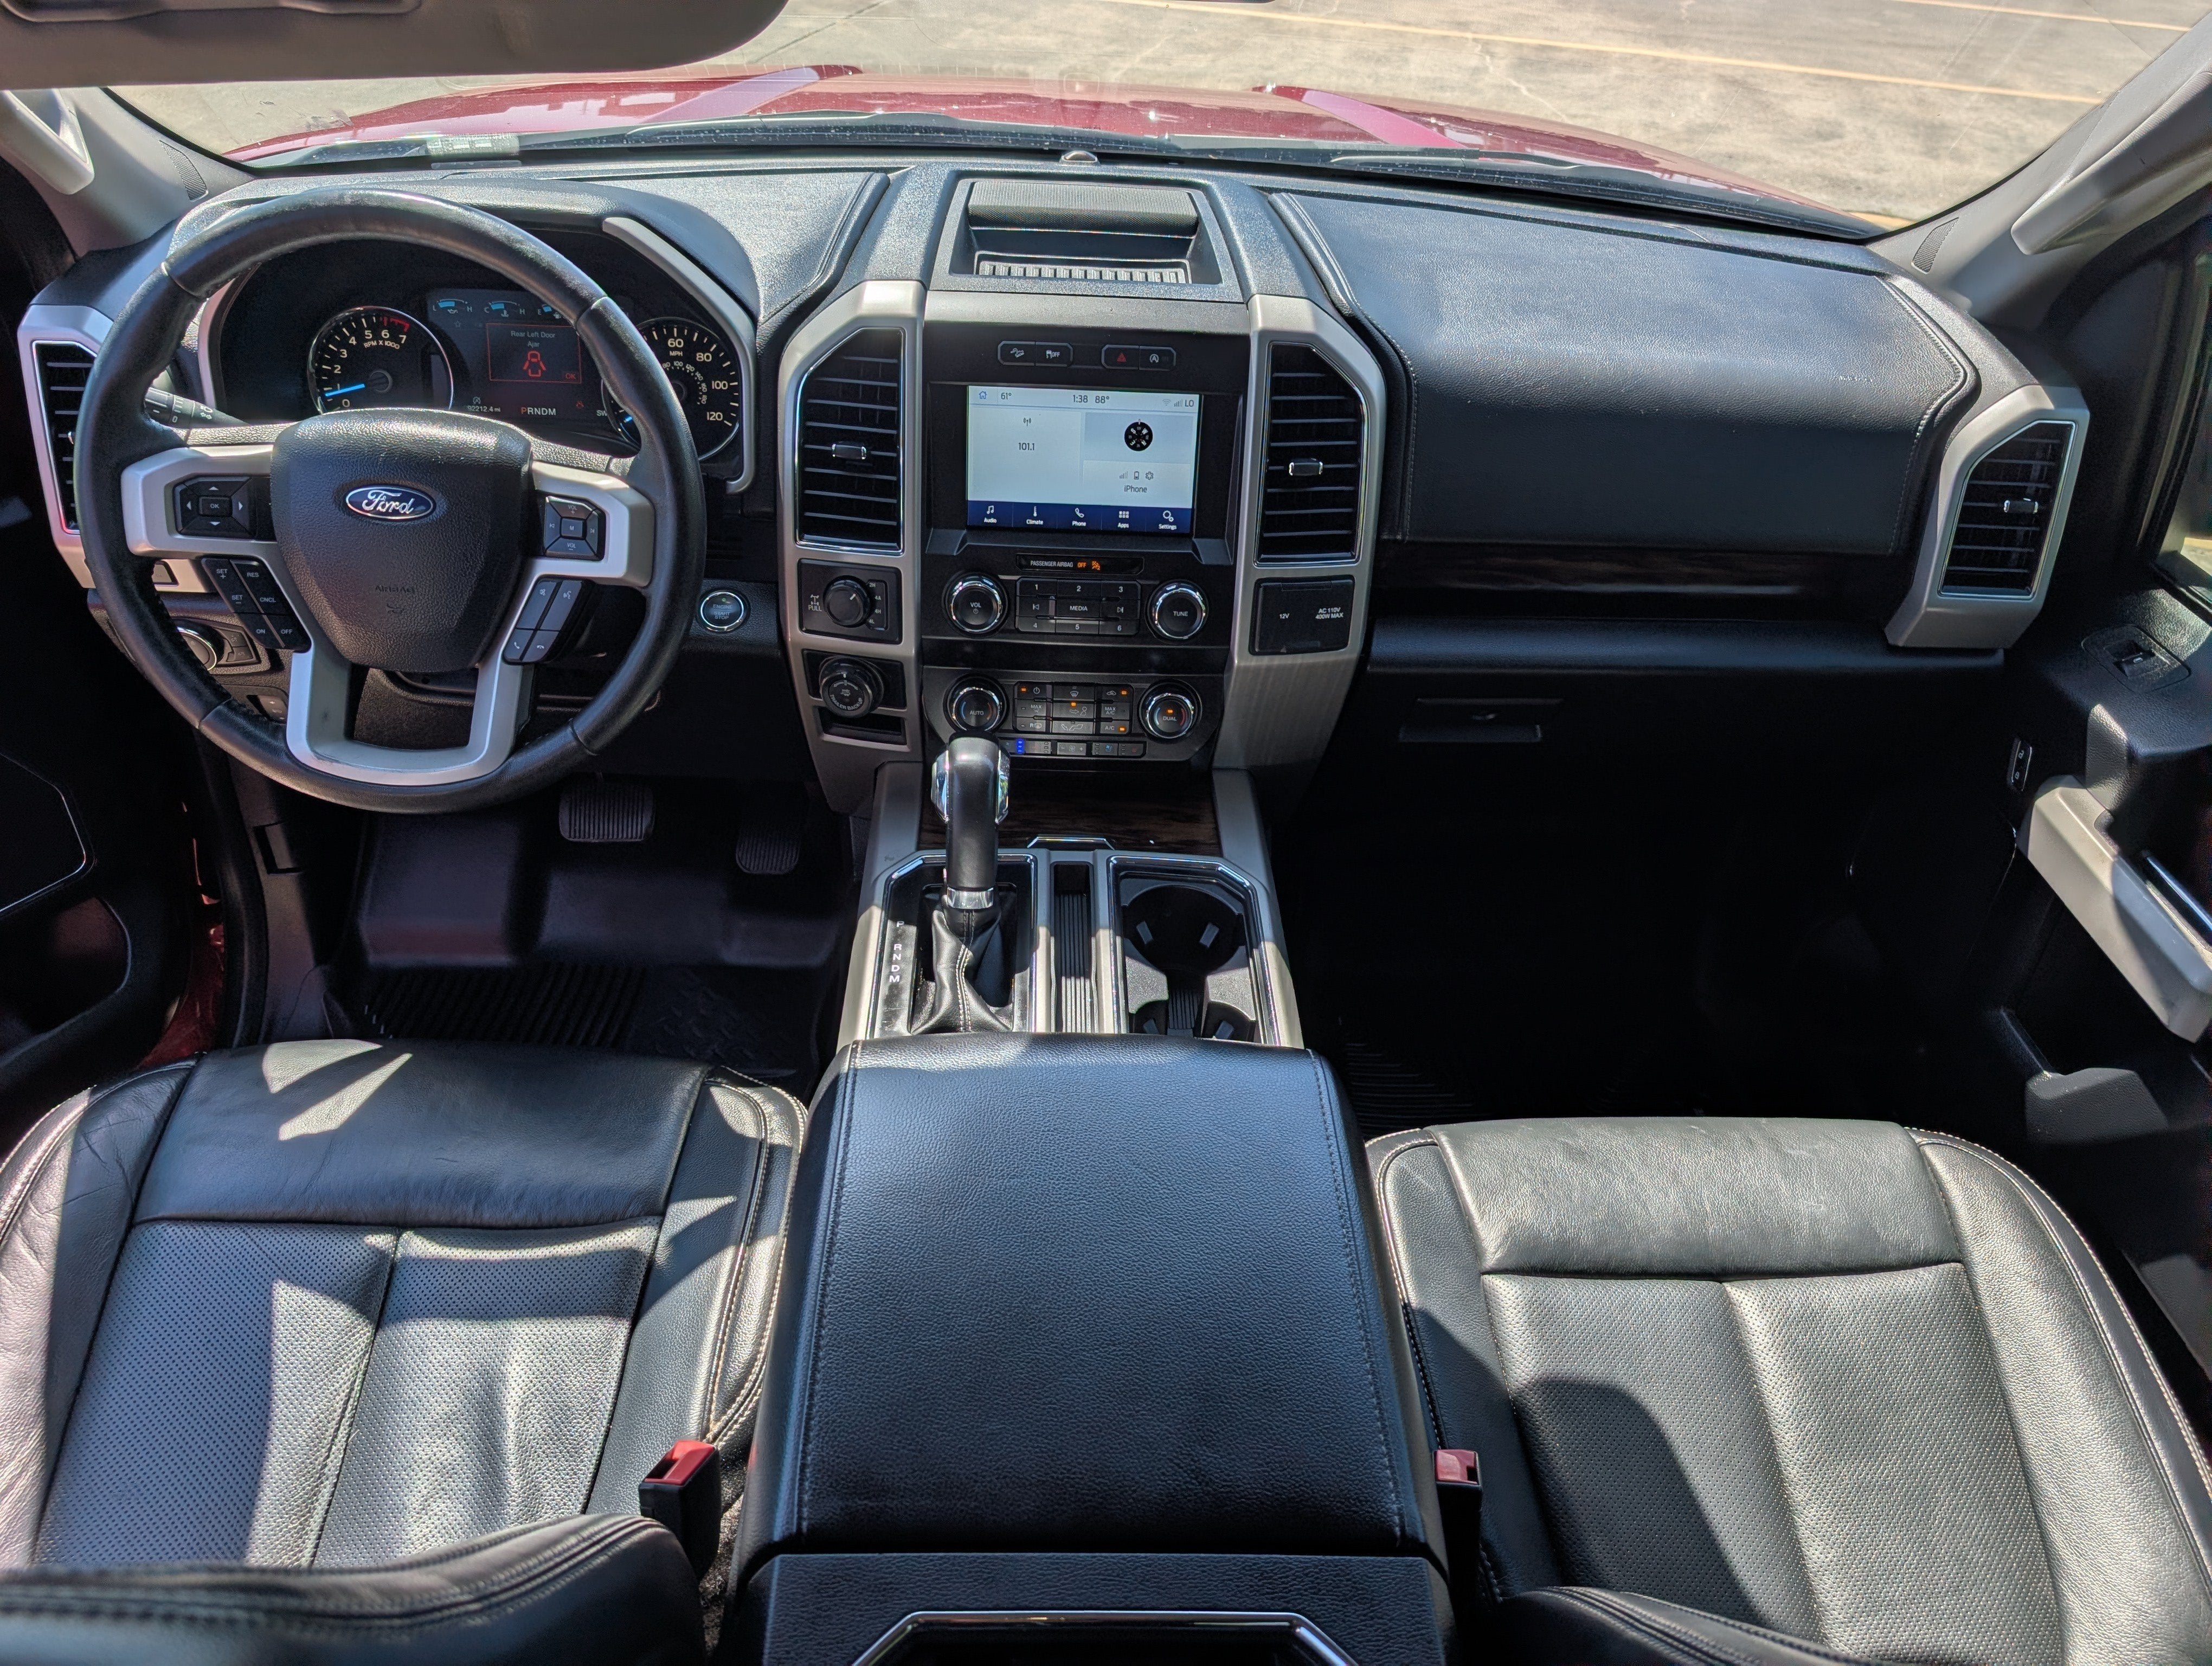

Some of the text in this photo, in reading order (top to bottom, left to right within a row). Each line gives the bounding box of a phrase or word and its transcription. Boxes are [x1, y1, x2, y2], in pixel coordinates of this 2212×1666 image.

[365, 330, 372, 339] 5
[381, 330, 390, 338] 6
[349, 336, 357, 345] 4
[399, 335, 407, 344] 7
[667, 338, 684, 348] 60
[364, 340, 377, 349] RPM
[385, 341, 400, 350] 1000
[339, 349, 348, 358] 3
[696, 353, 712, 362] 80
[333, 364, 342, 374] 2
[711, 380, 729, 390] 100
[342, 399, 350, 407] 0
[1072, 394, 1089, 403] 1:38
[1185, 399, 1194, 407] LO
[520, 407, 556, 416] PRNDM
[706, 412, 723, 421] 120
[1018, 442, 1036, 451] 101.1
[1123, 485, 1148, 494] iPhone
[362, 489, 416, 515] Ford
[830, 694, 863, 710] TRAILER BACKUP
